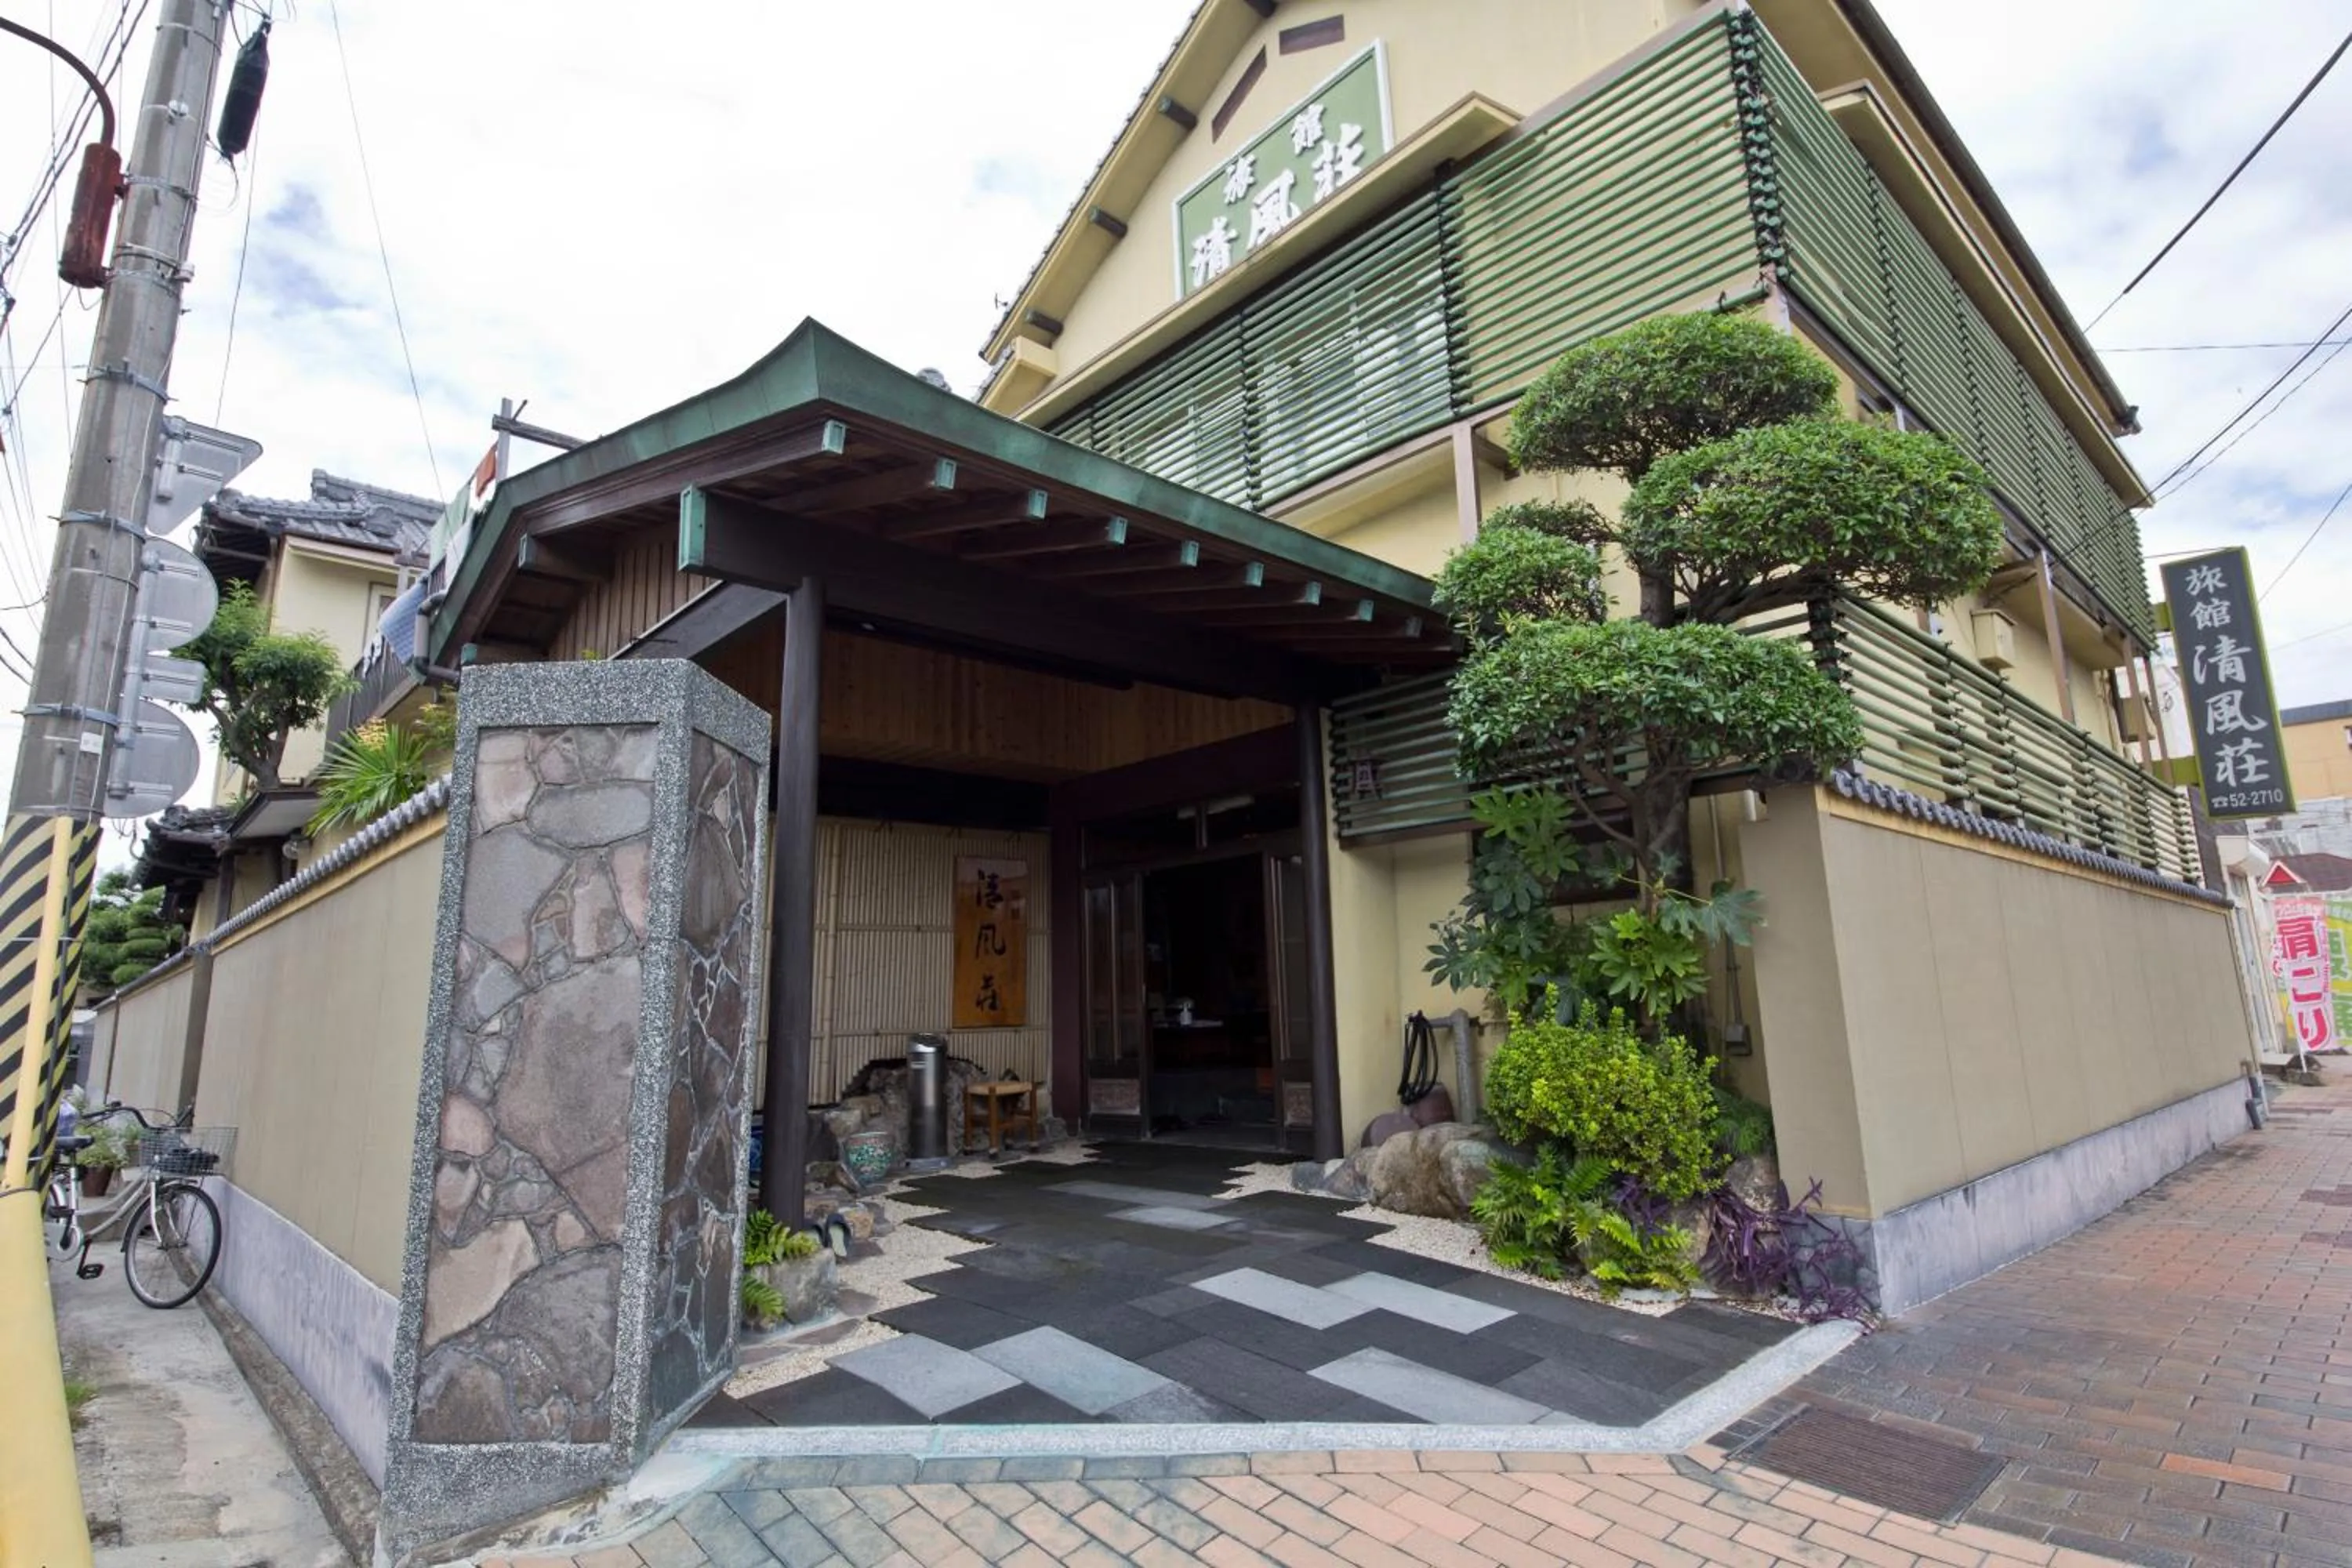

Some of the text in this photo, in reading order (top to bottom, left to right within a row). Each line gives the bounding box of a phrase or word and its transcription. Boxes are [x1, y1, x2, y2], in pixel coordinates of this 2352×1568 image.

[2229, 788, 2284, 808] 52-2710
[2276, 915, 2329, 1049] 肩こり
